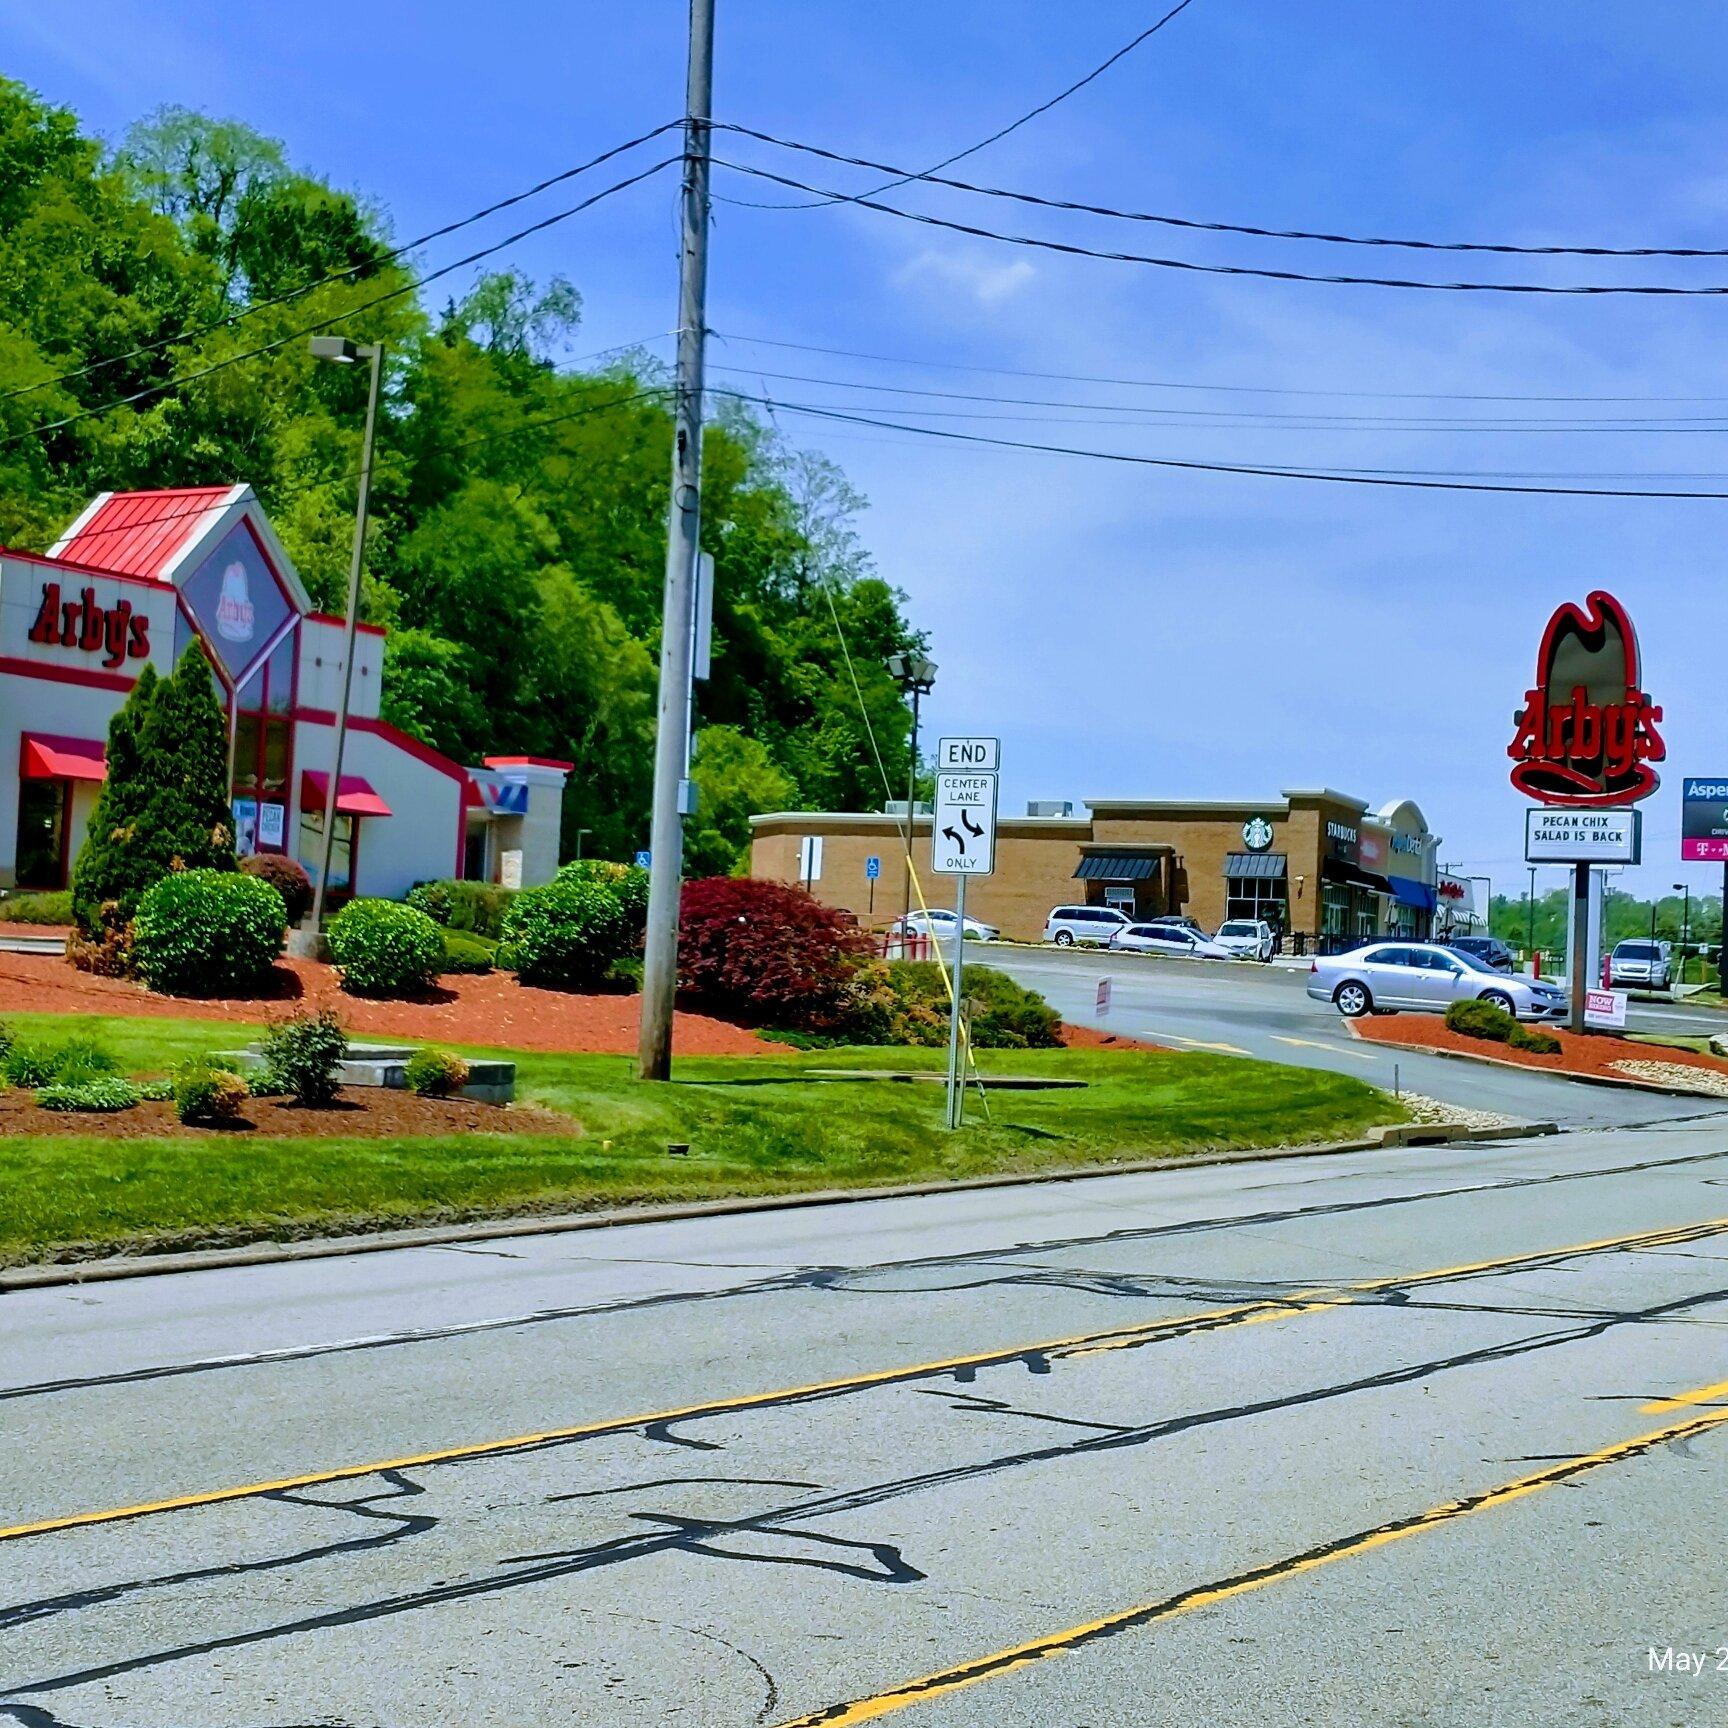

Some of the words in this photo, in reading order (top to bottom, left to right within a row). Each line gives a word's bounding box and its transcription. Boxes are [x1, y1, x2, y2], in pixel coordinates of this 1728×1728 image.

[28, 583, 150, 668] Arby's
[1507, 686, 1666, 777] Arby's
[949, 745, 986, 762] END
[944, 779, 987, 788] CENTER
[1688, 781, 1728, 799] Aspe
[950, 792, 980, 801] LANE
[1543, 817, 1578, 826] PECAN
[1582, 817, 1608, 827] CHIX
[1327, 821, 1356, 843] STARBUCKS
[1535, 831, 1569, 840] SALAD
[1574, 831, 1586, 841] IS
[1593, 832, 1622, 842] BACK
[947, 858, 976, 868] ONLY
[1590, 995, 1613, 1005] NOW
